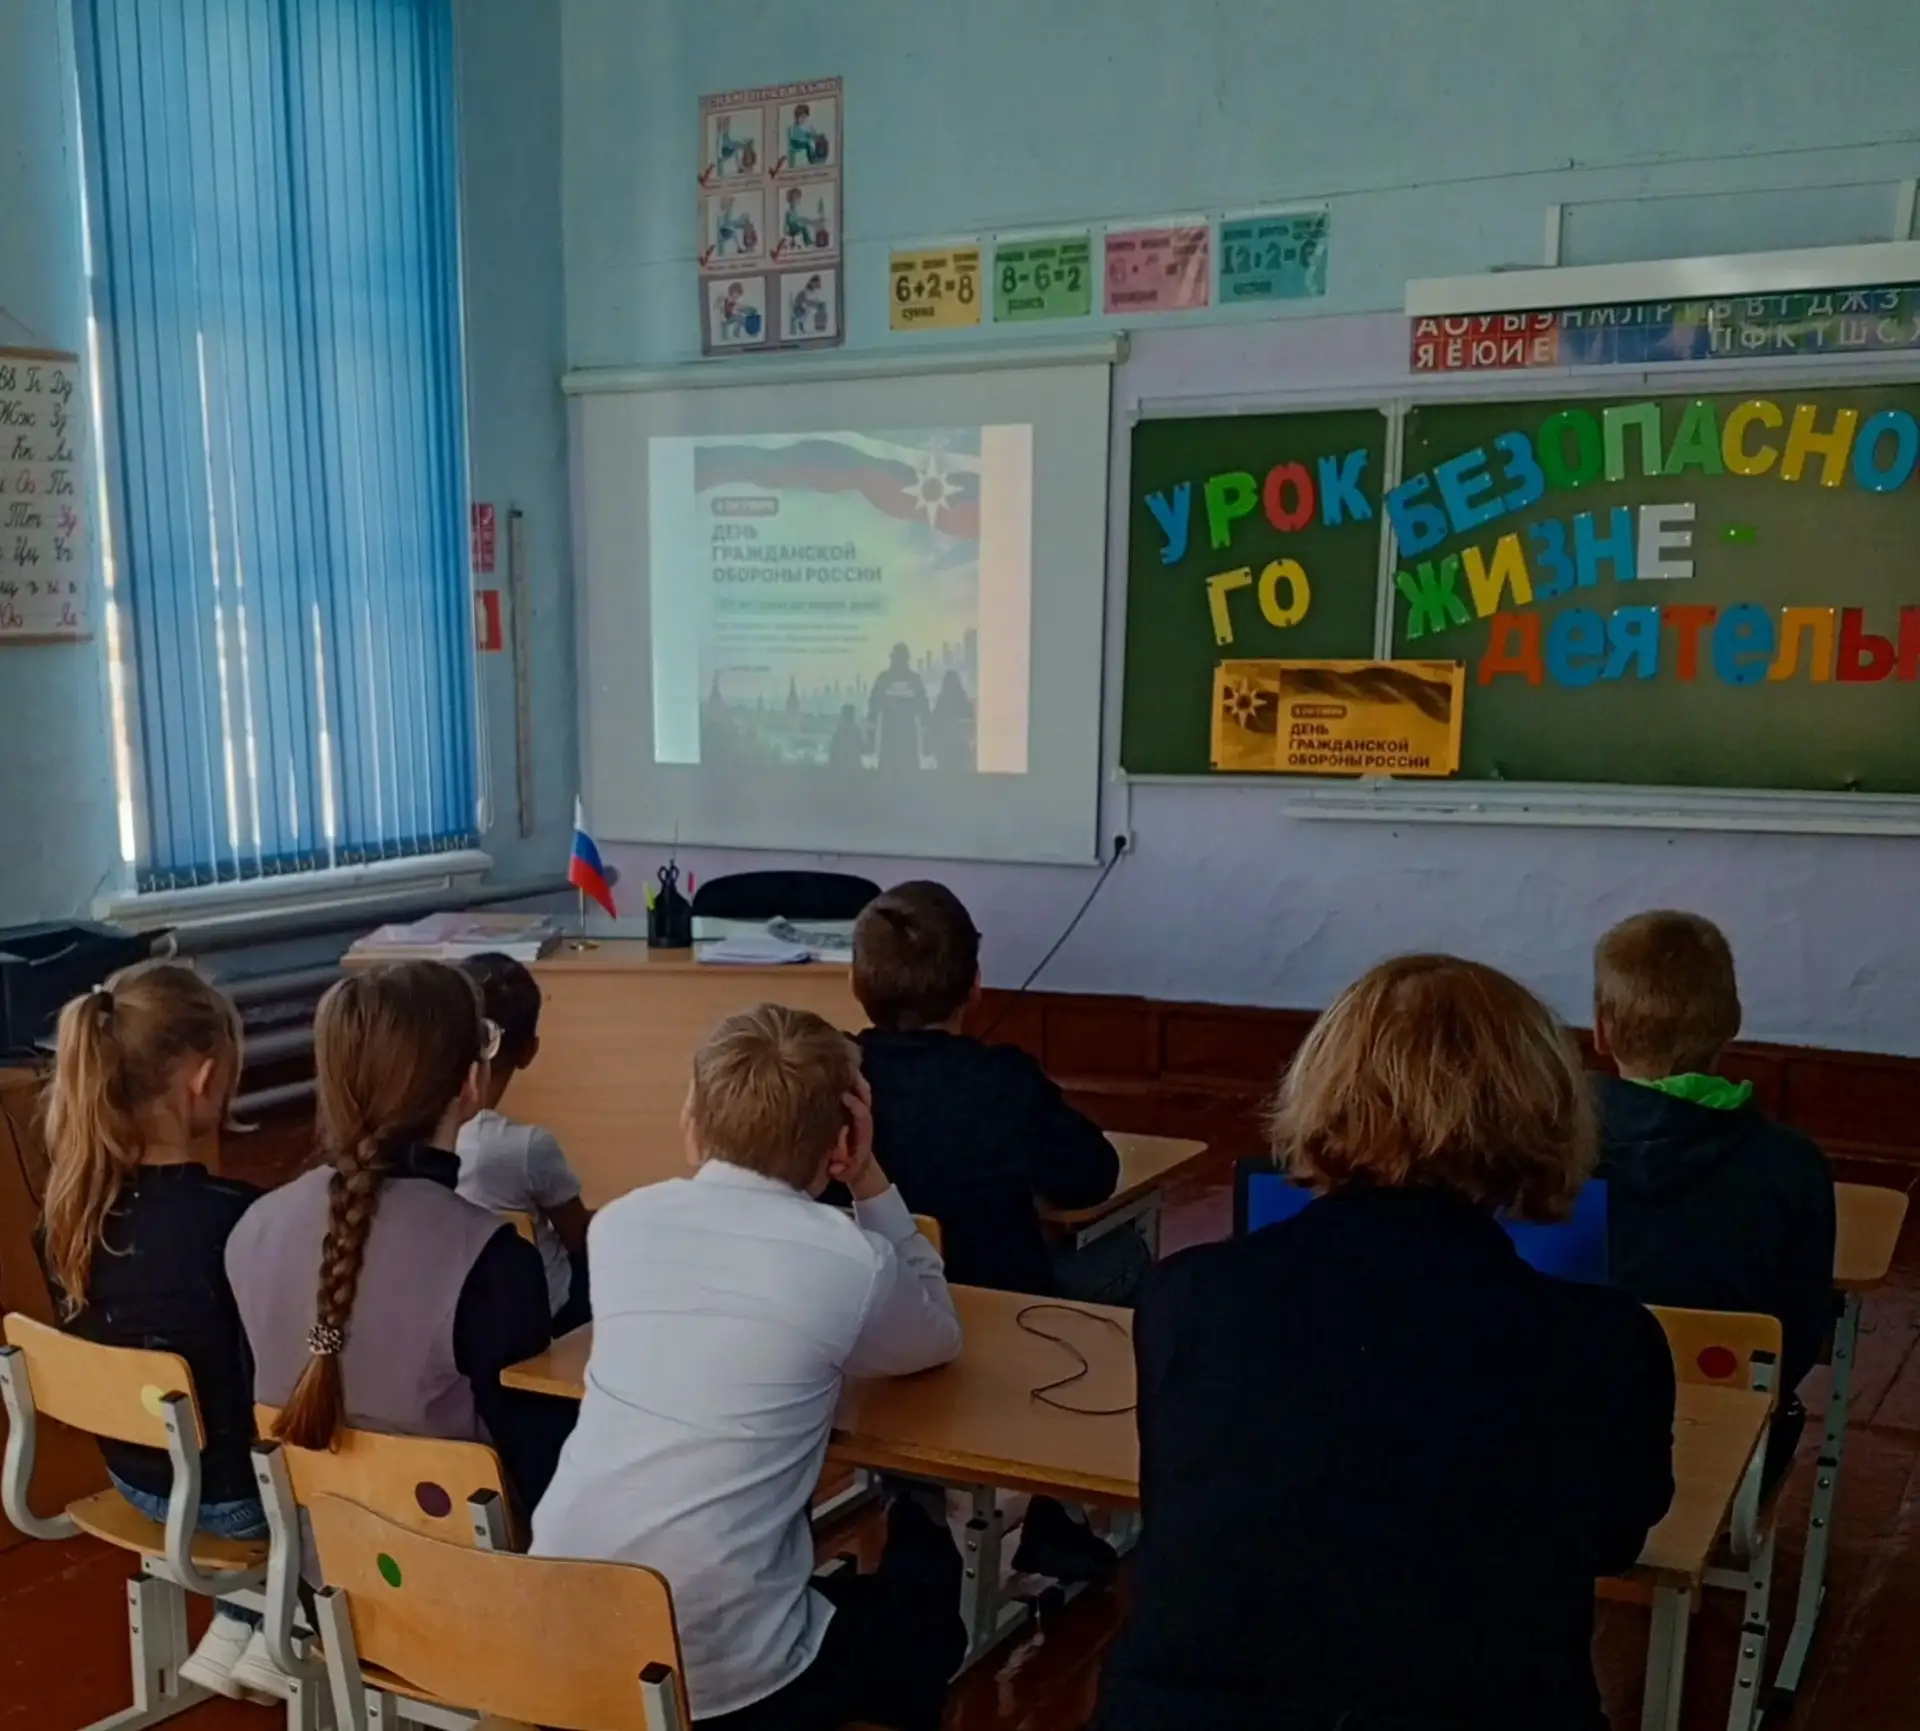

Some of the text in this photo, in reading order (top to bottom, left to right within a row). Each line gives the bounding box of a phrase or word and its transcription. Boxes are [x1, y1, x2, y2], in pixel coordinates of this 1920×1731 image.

[1384, 400, 1920, 559] БЕЗОПАСНО
[1144, 448, 1373, 565] УРОК
[712, 524, 759, 541] ДЕНЬ
[712, 542, 857, 562] ГРАЖДАНСКОЙ
[712, 567, 882, 583] ОБОРОНЫ РОССИИ
[1206, 558, 1311, 646] ГО
[1290, 723, 1329, 737] ДЕНЬ
[1289, 738, 1409, 754] ГРАЖДАНСКОЙ
[1288, 754, 1431, 769] ОБОРОНЫ РОССИИ
